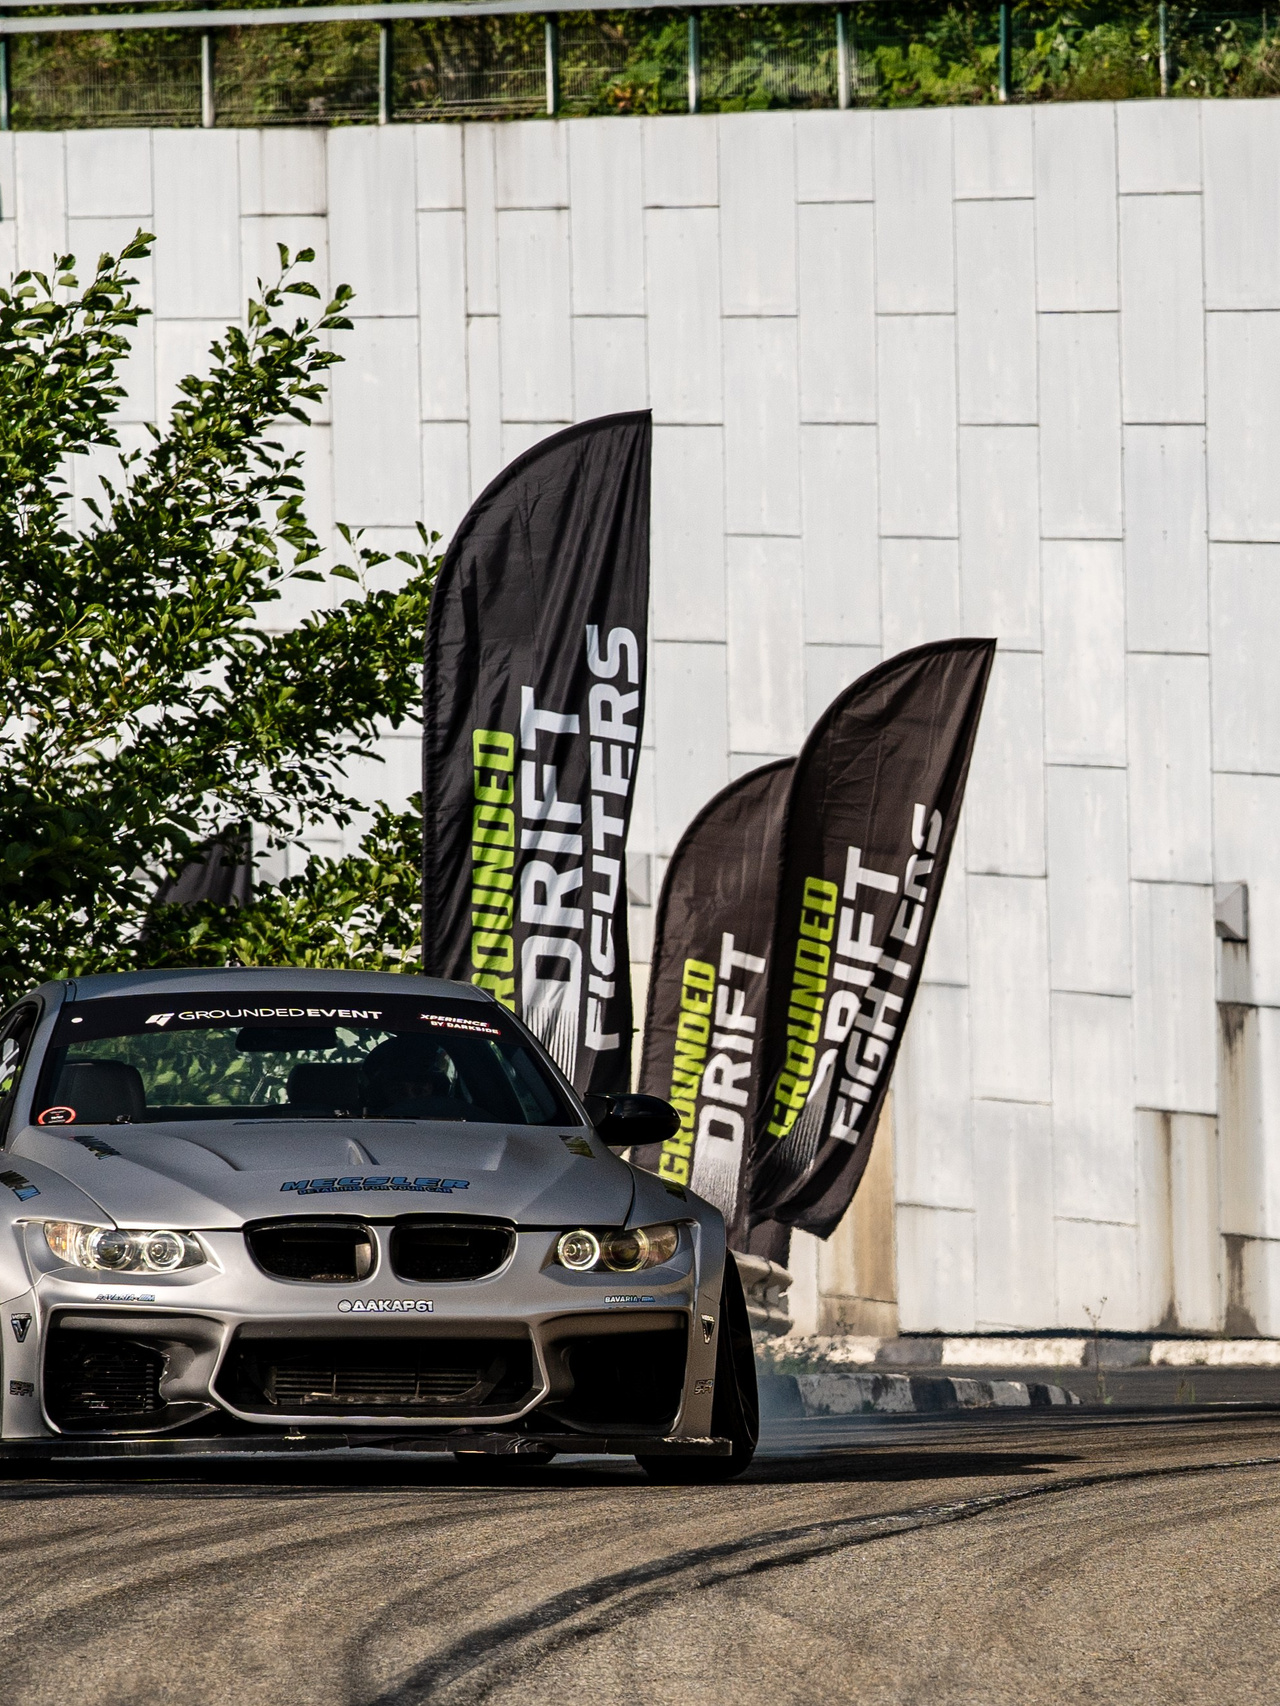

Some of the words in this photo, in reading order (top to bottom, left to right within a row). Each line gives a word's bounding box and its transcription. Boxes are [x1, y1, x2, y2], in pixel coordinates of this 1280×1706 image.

[471, 728, 515, 1013] ROUNDED
[520, 685, 584, 1085] DRIFT
[767, 876, 839, 1138] GROUNDED
[690, 932, 766, 1226] DRIFT
